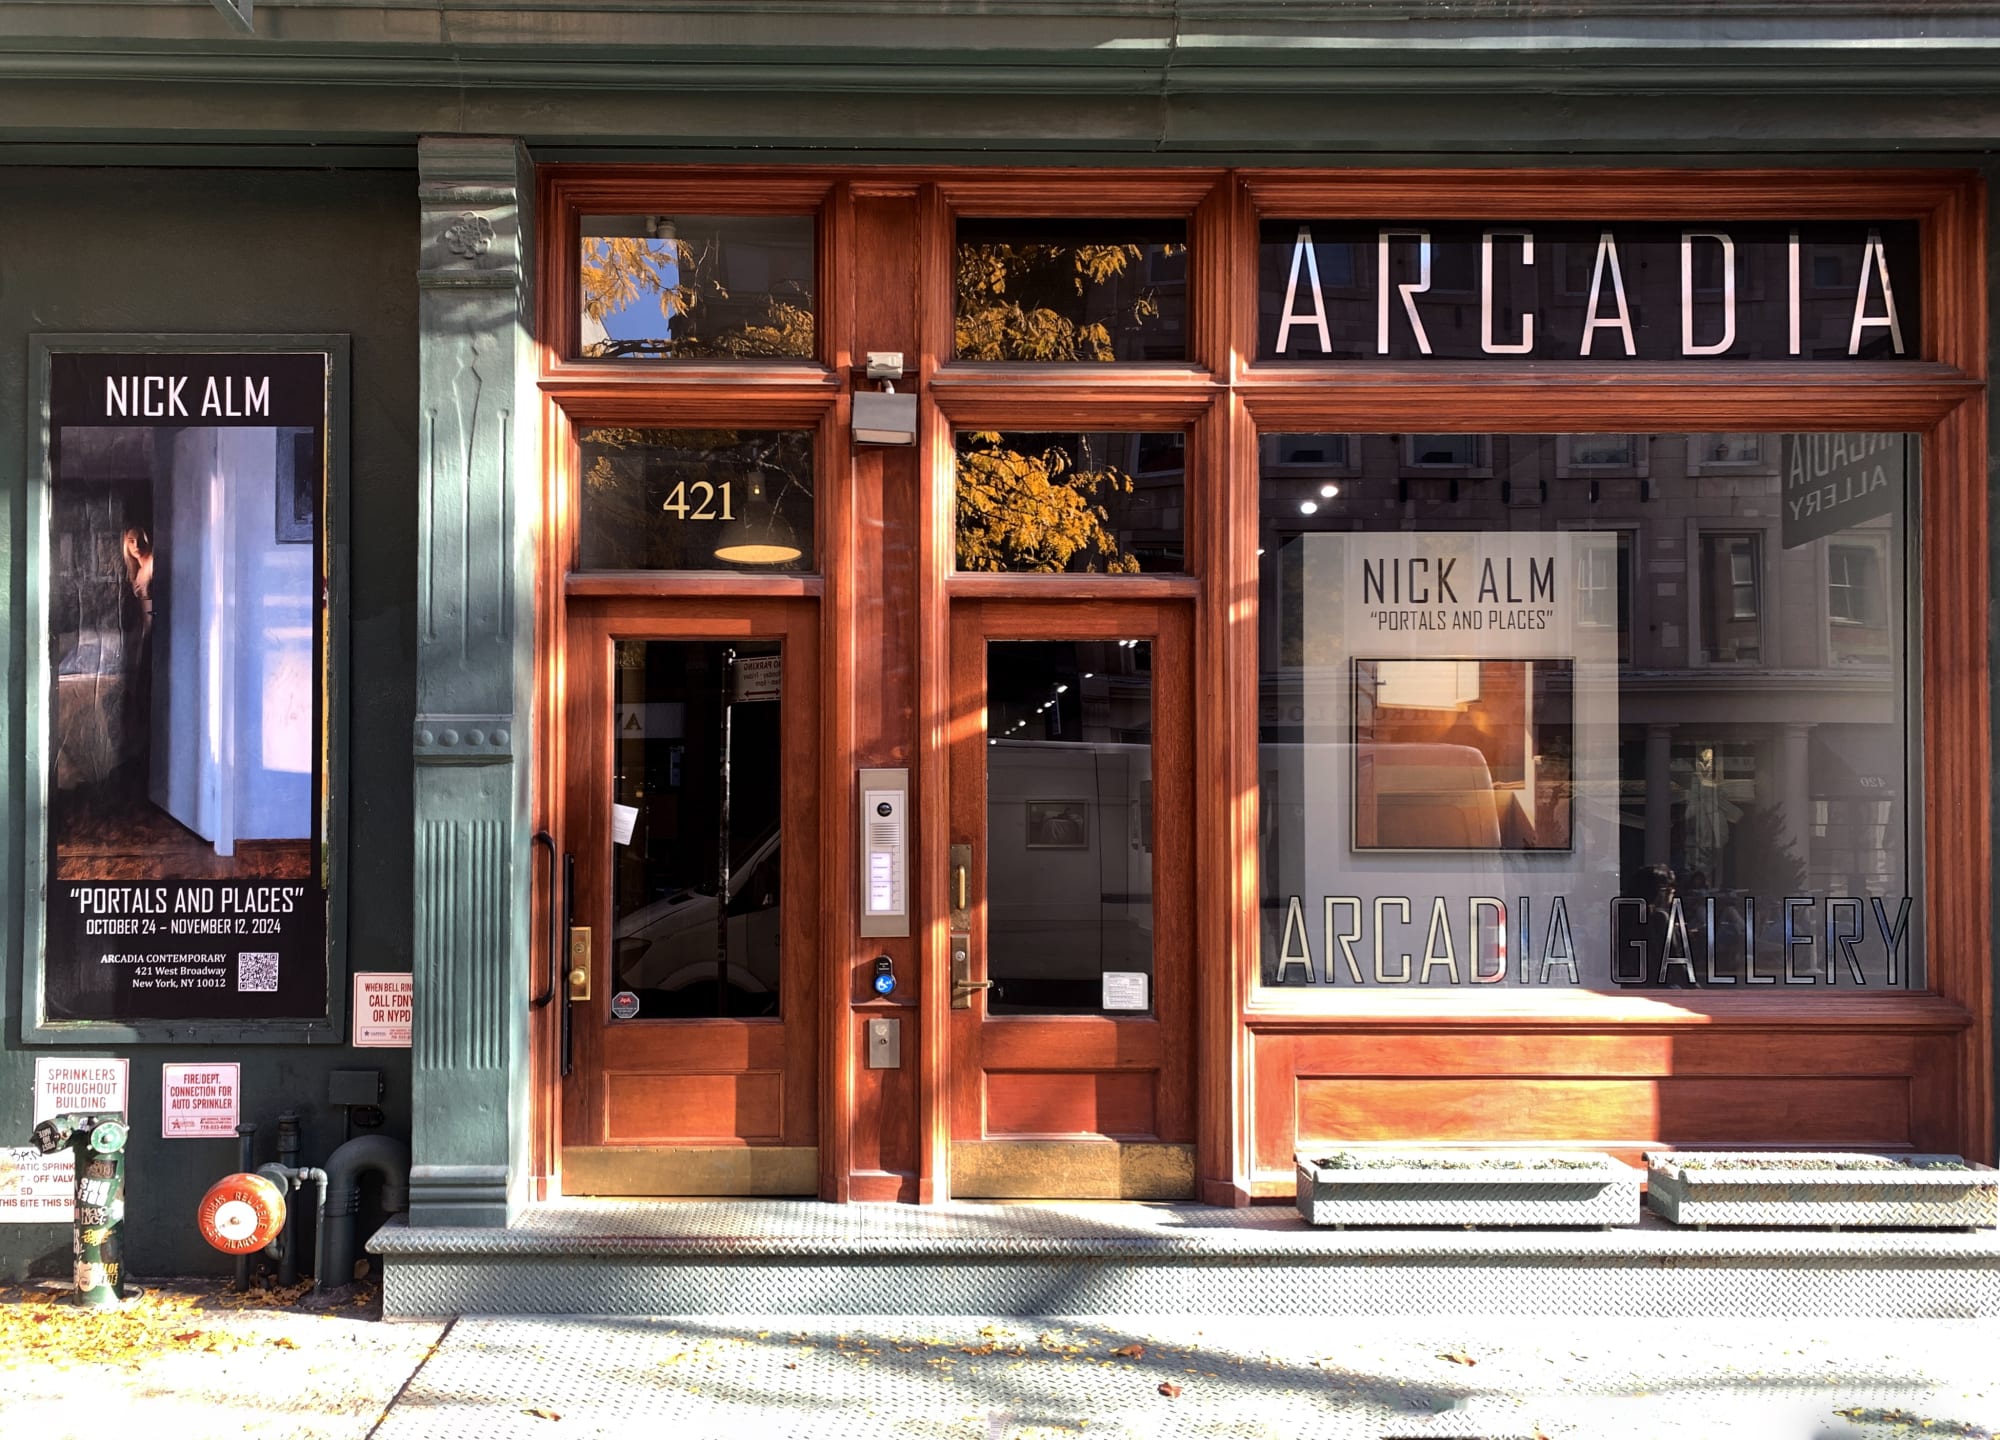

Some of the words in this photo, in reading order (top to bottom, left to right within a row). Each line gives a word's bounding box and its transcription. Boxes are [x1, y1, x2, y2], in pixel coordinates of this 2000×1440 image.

[1274, 226, 1905, 356] ARCADIA
[105, 375, 189, 417] NICK
[200, 375, 271, 417] ALM
[662, 480, 737, 521] 421
[1363, 557, 1459, 604] NICK
[1478, 556, 1555, 603] ALM
[1370, 610, 1446, 631] “PORTALS
[1452, 609, 1482, 630] AND
[1488, 609, 1554, 630] PLACES”
[69, 887, 167, 914] “PORTALS
[174, 887, 214, 913] AND
[221, 887, 304, 913] PLACES”
[86, 918, 139, 935] OCTOBER
[141, 918, 156, 935] 24
[171, 918, 232, 934] NOVEMBER
[234, 918, 249, 936] 12,
[252, 918, 281, 934] 2024
[1276, 895, 1580, 984] ARCADIA
[1609, 896, 1914, 985] GALLERY
[100, 953, 144, 963] ARCADIA
[146, 953, 227, 963] CONTEMPORARY
[134, 966, 152, 976] 421
[155, 966, 178, 976] West
[180, 966, 227, 978] Broadway
[132, 978, 153, 988] New
[155, 978, 179, 989] York,
[180, 978, 195, 988] NY
[196, 978, 226, 988] 10012
[364, 982, 383, 993] WHEN
[384, 982, 400, 993] BELL
[400, 982, 413, 993] RIN
[369, 994, 390, 1008] CALL
[372, 1009, 385, 1023] OR
[387, 1009, 411, 1023] NYPD
[48, 1068, 116, 1081] SPRINKLERS
[183, 1073, 200, 1084] FIRE
[201, 1073, 221, 1085] DEPT.
[46, 1082, 118, 1095] THROUGHOUT
[170, 1086, 216, 1097] CONNECTION
[218, 1086, 232, 1097] FOR
[55, 1096, 106, 1109] BUILDING
[171, 1098, 191, 1109] AUTO
[192, 1098, 232, 1109] SPRINKLER
[42, 1162, 75, 1171] SPRINK
[33, 1175, 50, 1183] OFF
[53, 1175, 74, 1183] VALV
[42, 1198, 62, 1207] THIS
